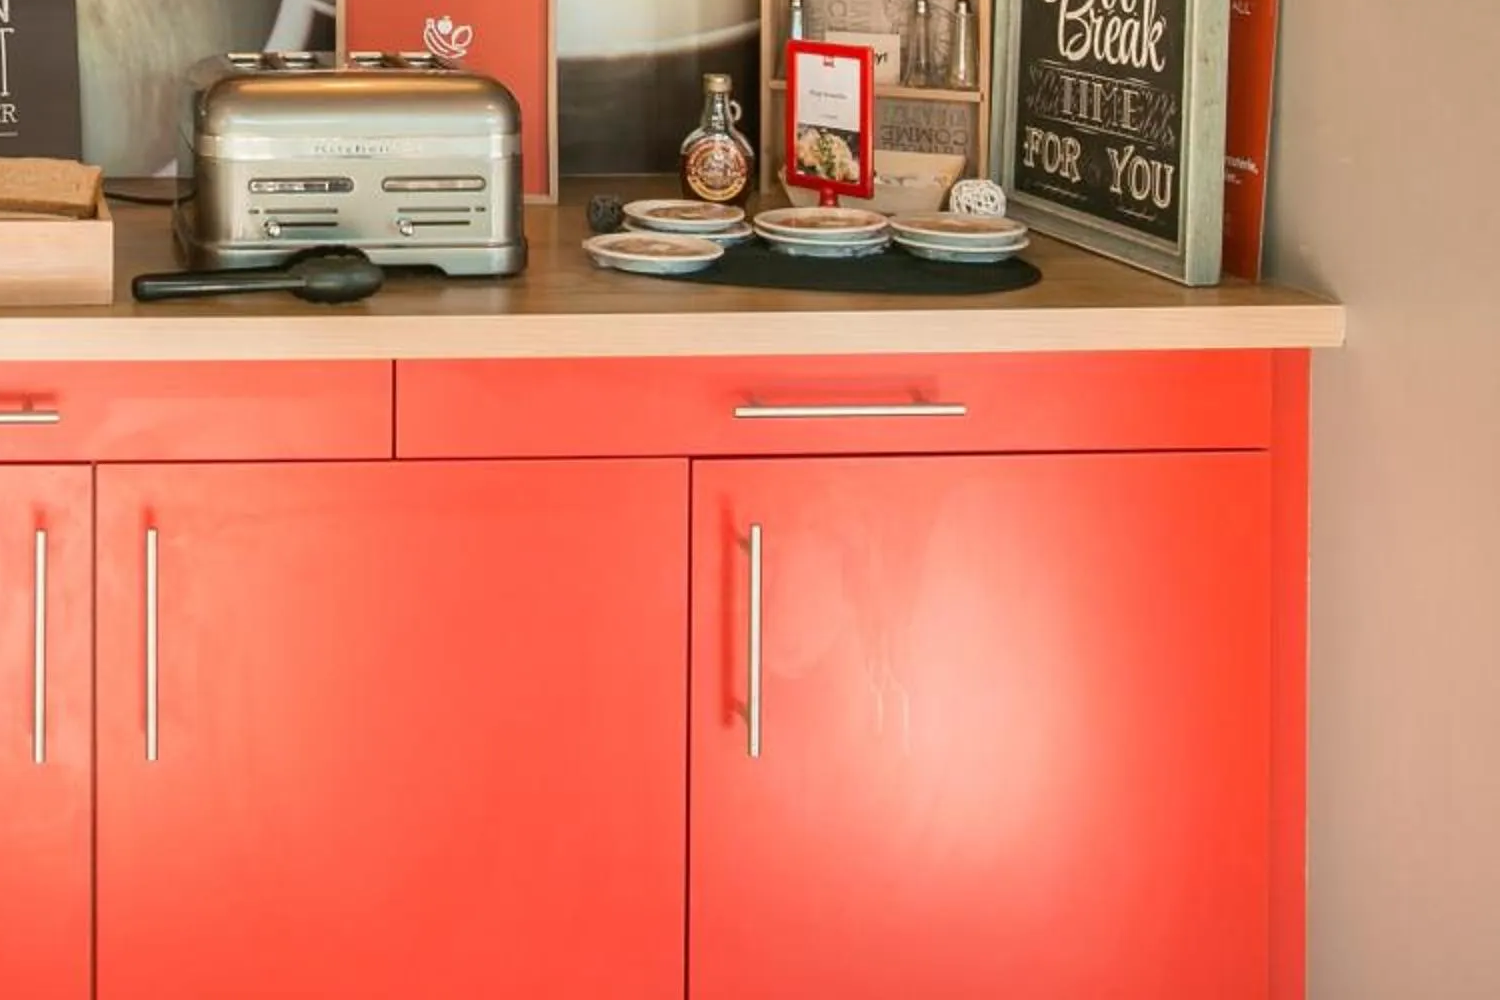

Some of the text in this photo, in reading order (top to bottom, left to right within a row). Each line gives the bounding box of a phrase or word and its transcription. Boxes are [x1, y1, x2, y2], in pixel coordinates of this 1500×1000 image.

[1060, 75, 1140, 132] TIME
[1023, 125, 1082, 184] FOR
[1106, 144, 1175, 209] YOU
